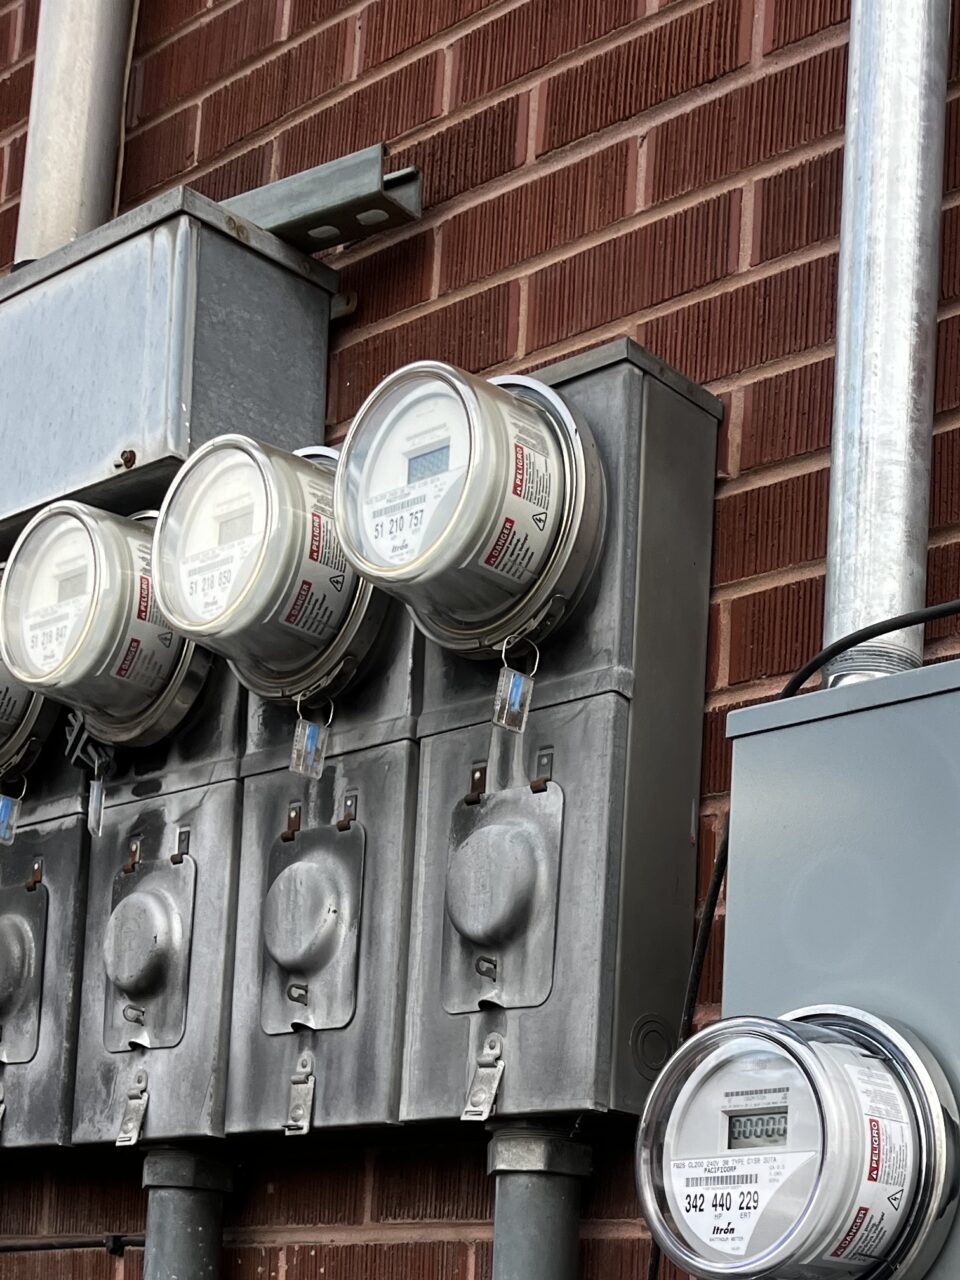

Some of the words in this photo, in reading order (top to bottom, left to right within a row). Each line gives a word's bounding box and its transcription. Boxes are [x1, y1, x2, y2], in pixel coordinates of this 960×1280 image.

[312, 515, 321, 549] PELIGRO
[374, 522, 384, 540] 51
[389, 515, 405, 535] 210
[409, 509, 424, 529] 757
[493, 522, 513, 557] DANGER
[141, 579, 149, 611] PELIGRO
[189, 580, 198, 596] 51
[292, 584, 310, 615] DANGER
[871, 1121, 879, 1167] PELIGRO
[704, 1166, 737, 1174] PACIFICORP
[685, 1194, 705, 1213] 342
[712, 1192, 732, 1212] 440
[738, 1191, 759, 1210] 229
[712, 1222, 735, 1235] Itron
[843, 1210, 866, 1247] DANGER
